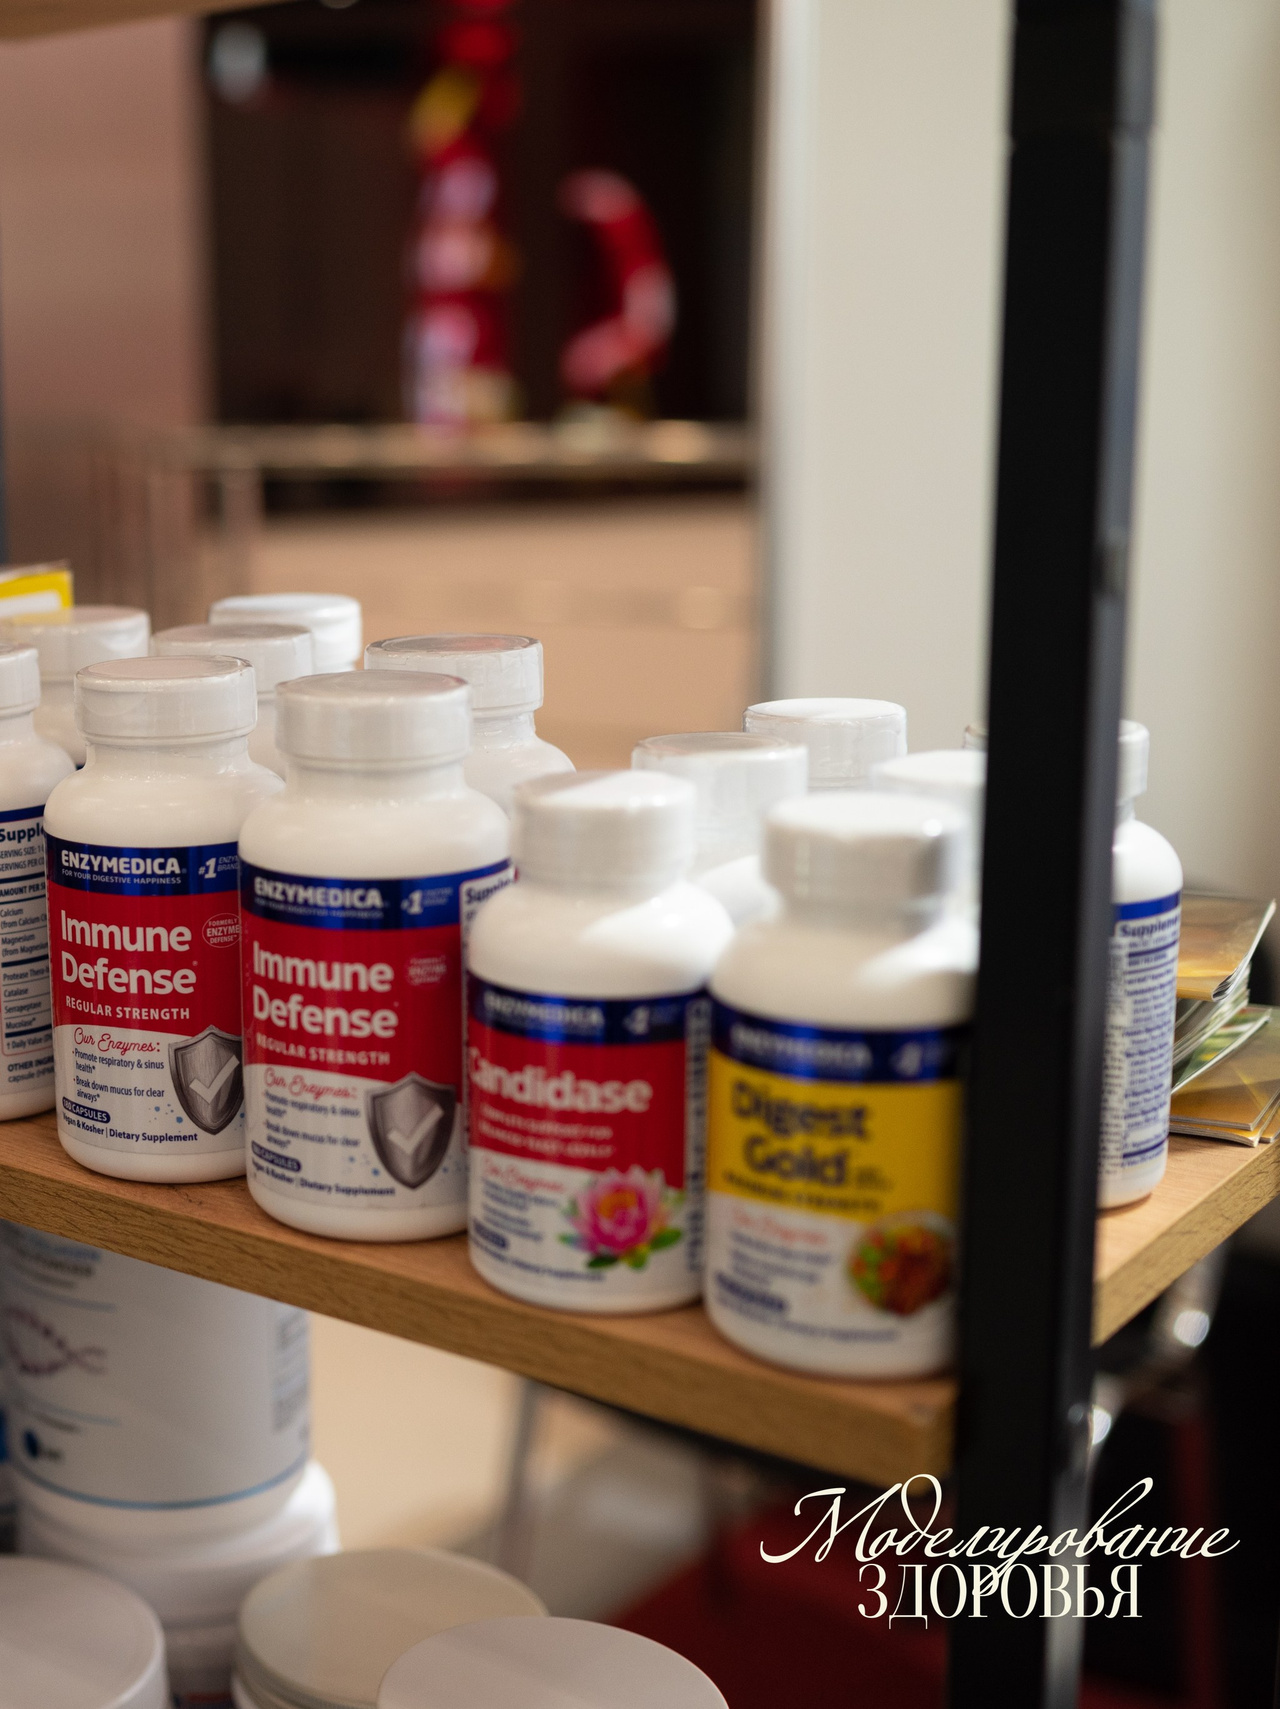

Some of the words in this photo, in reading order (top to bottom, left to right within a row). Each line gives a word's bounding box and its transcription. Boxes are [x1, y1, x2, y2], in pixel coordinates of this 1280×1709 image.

[62, 868, 73, 876] FOR
[74, 871, 91, 880] YOUR
[92, 874, 132, 884] DIGESTIVE
[133, 876, 182, 885] HAPPINESS
[198, 858, 216, 879] #1
[0, 885, 27, 897] AMOUNT
[254, 876, 384, 908] ENZYMEDICA
[61, 909, 192, 952] Immune
[207, 924, 240, 937] ENZYME
[208, 918, 238, 927] FORMERLY
[61, 950, 197, 995] Defense
[253, 940, 394, 993] Immune
[65, 995, 112, 1017] REGULAR
[116, 1007, 190, 1020] STRENGTH
[253, 984, 399, 1039] Defense
[74, 1027, 96, 1045] Our
[98, 1033, 160, 1056] Enzymes:
[256, 1031, 307, 1059] REGULAR
[308, 1047, 391, 1065] STRENGTH
[7, 1060, 33, 1072] OTHER
[75, 1047, 97, 1062] Promote
[99, 1056, 135, 1070] respiratory
[136, 1059, 143, 1068] &
[144, 1060, 165, 1069] sinus
[76, 1075, 91, 1088] Break
[91, 1080, 108, 1092] down
[110, 1086, 132, 1095] mucus
[134, 1087, 144, 1097] for
[146, 1087, 165, 1097] clear
[72, 1103, 108, 1122] CAPSULES
[733, 1080, 868, 1141] Digest
[81, 1121, 104, 1135] Kosher
[109, 1128, 140, 1142] Dietary
[142, 1132, 198, 1143] Supplement
[743, 1134, 849, 1188] Gold
[335, 1184, 395, 1197] Supplement
